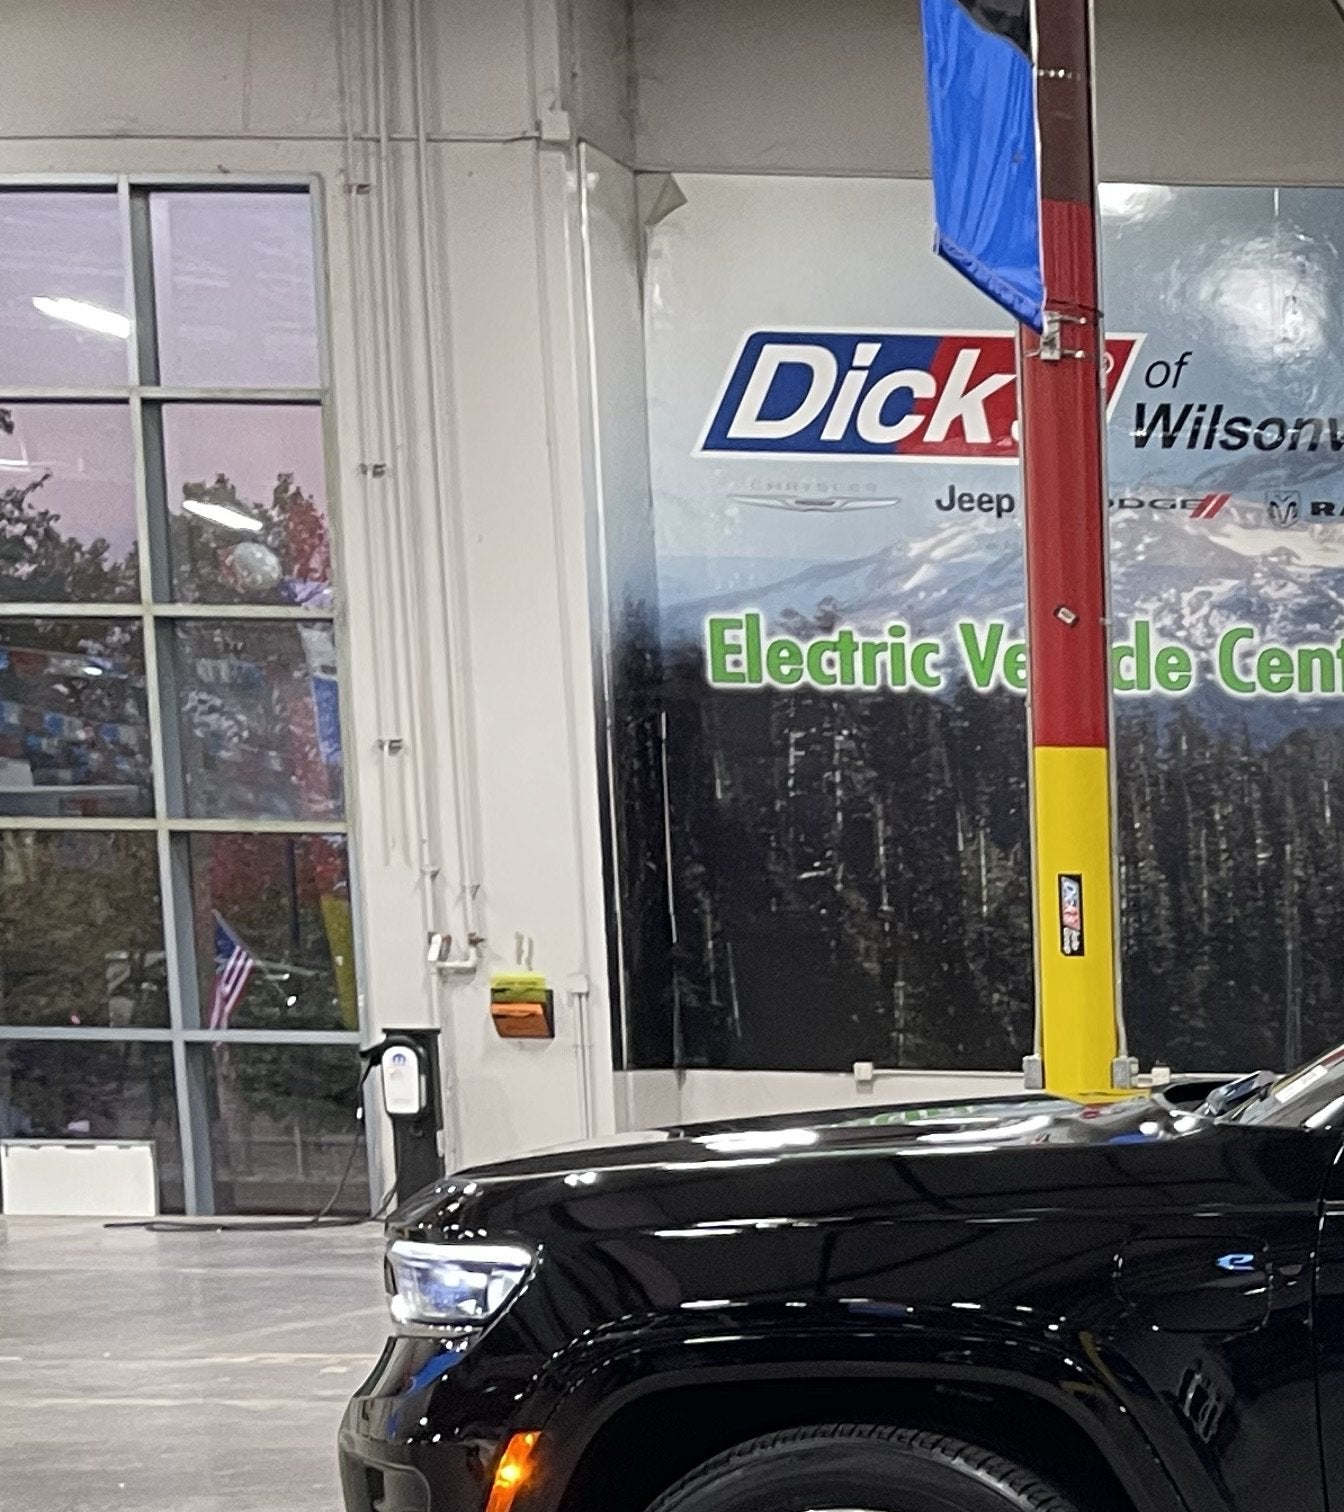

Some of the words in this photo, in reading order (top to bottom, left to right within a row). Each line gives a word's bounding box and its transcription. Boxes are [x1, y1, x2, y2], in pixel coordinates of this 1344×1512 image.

[727, 342, 1019, 445] Dick
[1144, 350, 1192, 389] of
[935, 484, 1016, 518] Jeep
[708, 612, 941, 688] Electric
[958, 620, 1192, 691] Vecle
